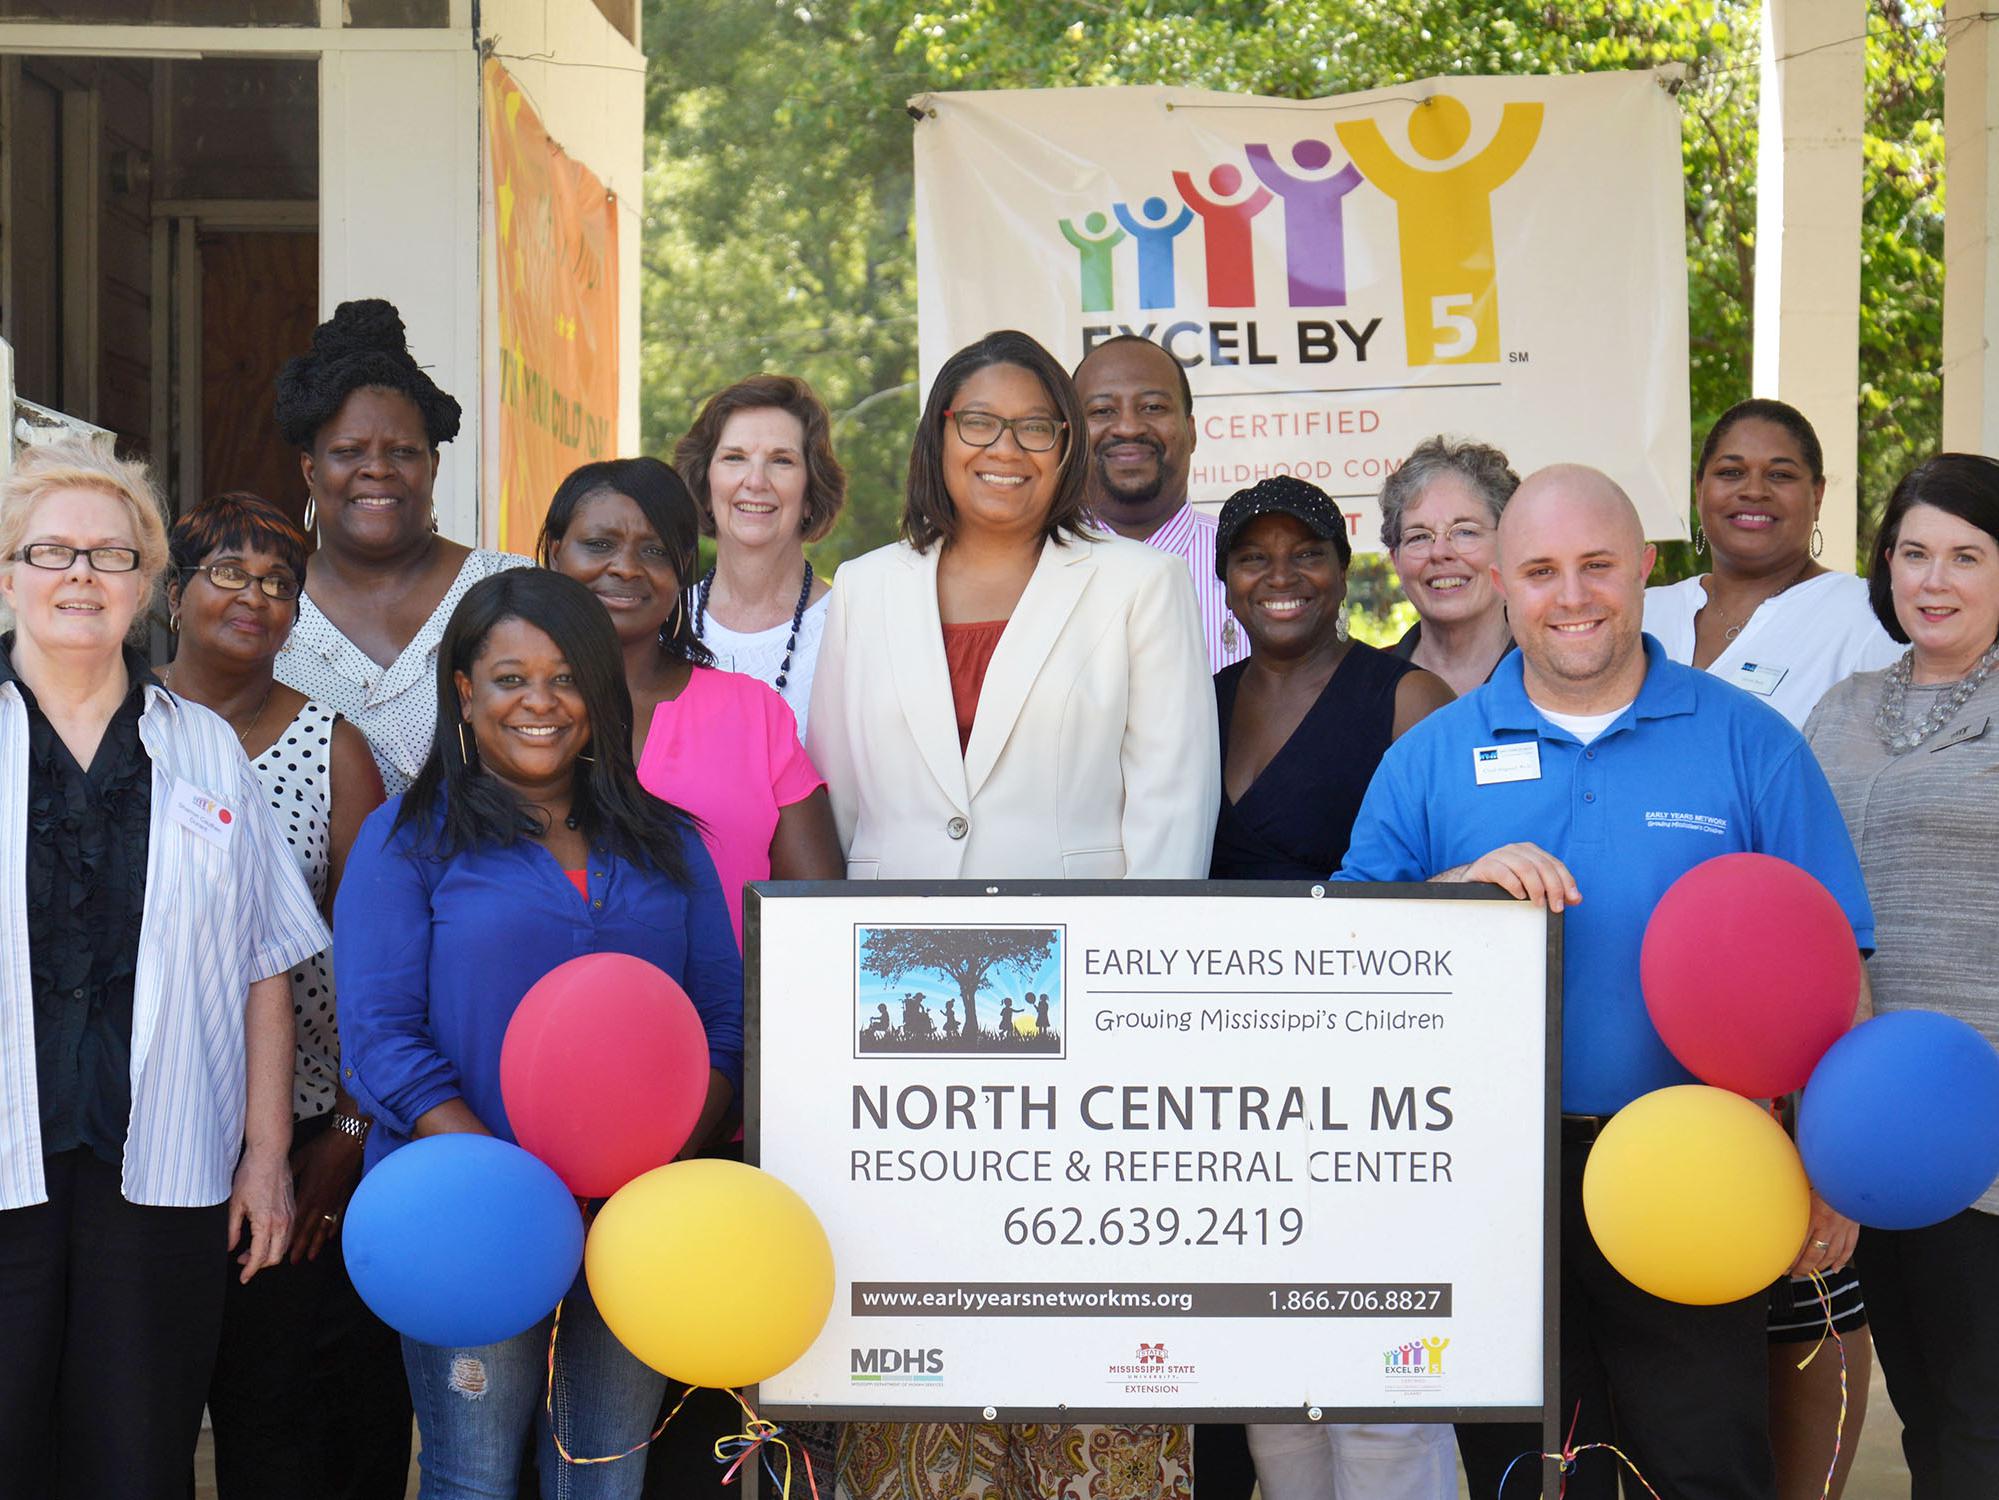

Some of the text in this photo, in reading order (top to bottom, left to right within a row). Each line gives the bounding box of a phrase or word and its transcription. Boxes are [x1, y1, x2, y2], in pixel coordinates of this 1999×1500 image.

[1297, 317, 1384, 364] BY
[1431, 293, 1478, 359] 5
[1508, 351, 1530, 363] SM
[1203, 409, 1381, 440] CERTIFIED
[1193, 459, 1333, 484] HILDHOOD
[1645, 811, 1727, 827] EARLY YEARS NETWORK
[1085, 948, 1453, 977] EARLY YEARS NETWORK
[1095, 1008, 1444, 1033] Growing Mississippi's Children
[852, 1084, 1454, 1132] NORTH CENTRAL MS
[850, 1149, 1453, 1183] RESOURCE & REFERRAL CENTER
[1003, 1206, 1304, 1247] 662.639.2419
[862, 1288, 1441, 1311] www.earlyyearsnetworkms.org 1.866.706.8827
[850, 1348, 944, 1374] MDHS
[1109, 1365, 1196, 1374] MISSISSIPPI STATE
[1385, 1366, 1412, 1374] EXCEL
[1413, 1366, 1426, 1374] BY
[1124, 1384, 1179, 1394] EXTENSION
